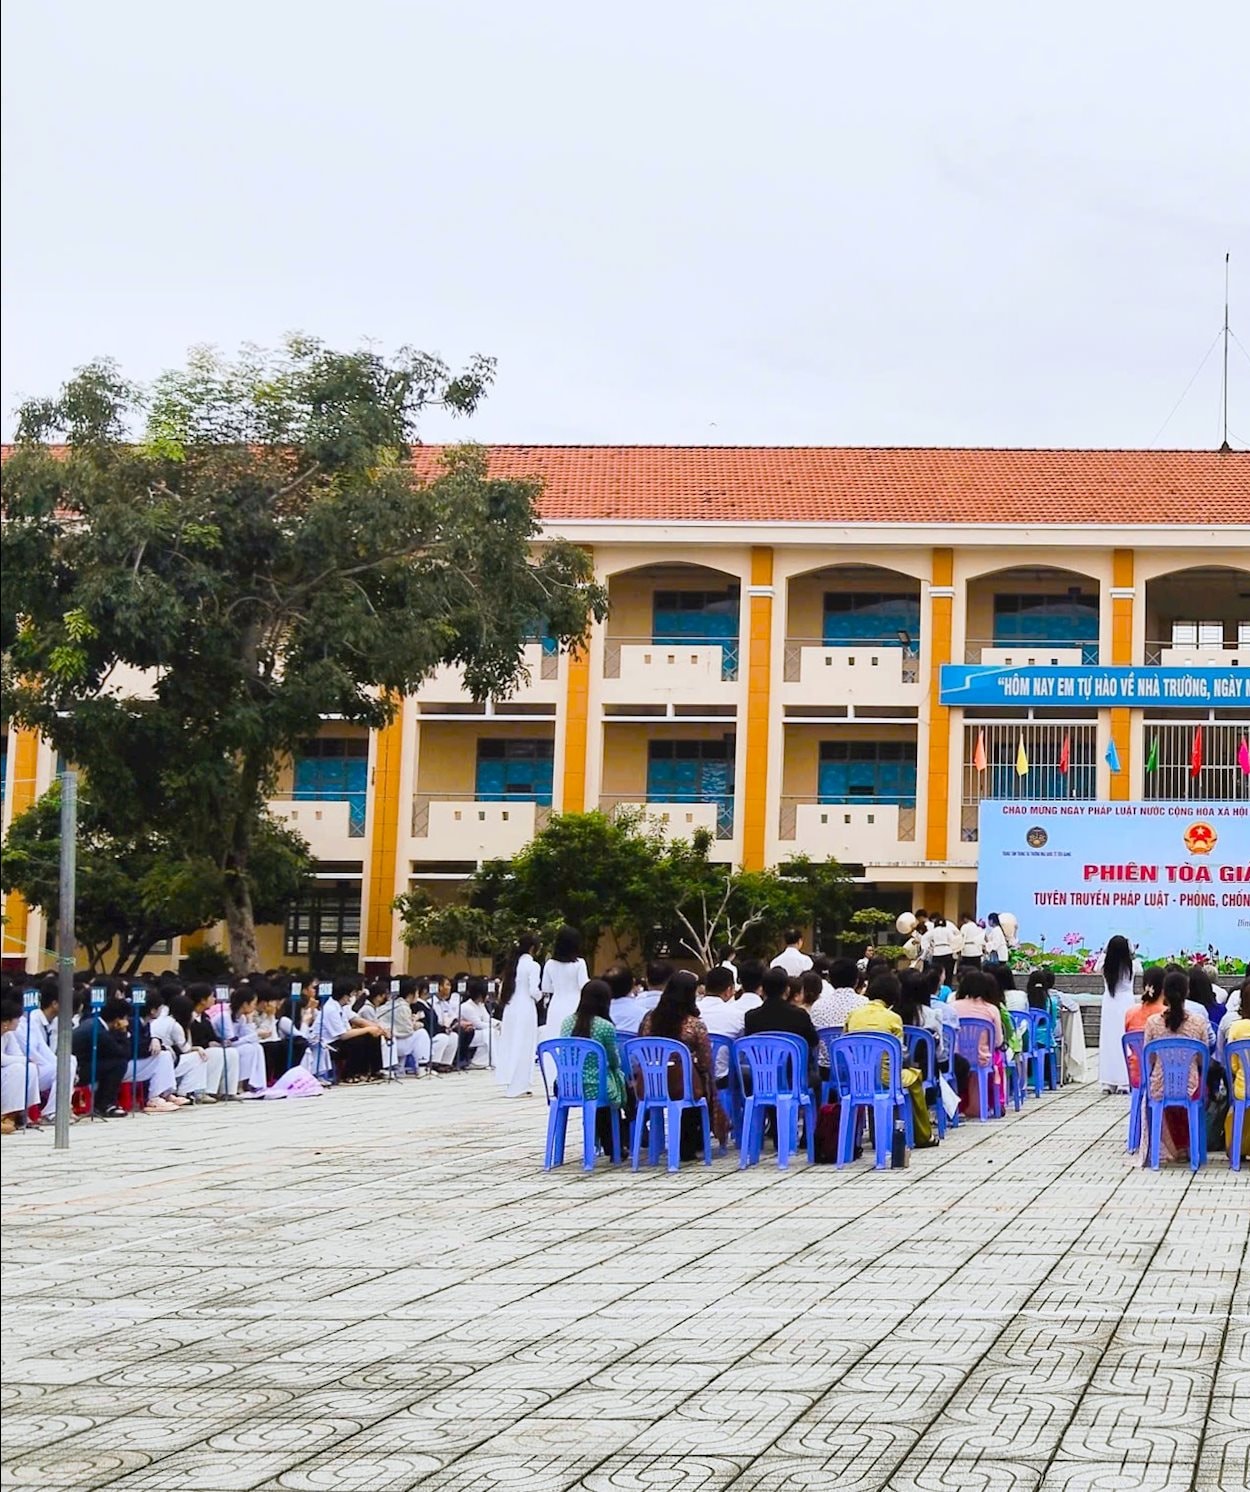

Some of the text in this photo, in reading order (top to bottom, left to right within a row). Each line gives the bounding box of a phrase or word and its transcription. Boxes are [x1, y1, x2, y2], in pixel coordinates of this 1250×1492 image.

[1033, 677, 1054, 697] NAY
[1057, 677, 1074, 697] EM
[1078, 676, 1093, 700] TỰ
[1095, 674, 1116, 697] HÀO
[1120, 672, 1136, 697] VỀ
[1138, 674, 1160, 697] NHÀ
[1163, 673, 1211, 700] TRƯỜNG,
[1214, 674, 1242, 698] NGÀY
[1030, 804, 1058, 815] MỪNG
[1088, 804, 1112, 816] PHÁP
[1115, 805, 1137, 817] LUẬT
[1140, 805, 1166, 816] NƯỚC
[1168, 805, 1194, 818] CỘNG
[1232, 805, 1248, 818] HỘI
[1083, 861, 1158, 883] PHIÊN
[1165, 862, 1213, 884] TÒA
[1034, 889, 1067, 906] TUYÊN
[1113, 889, 1141, 907] PHÁP
[1144, 890, 1169, 909] LUẬT
[1179, 889, 1218, 908] PHÒNG,
